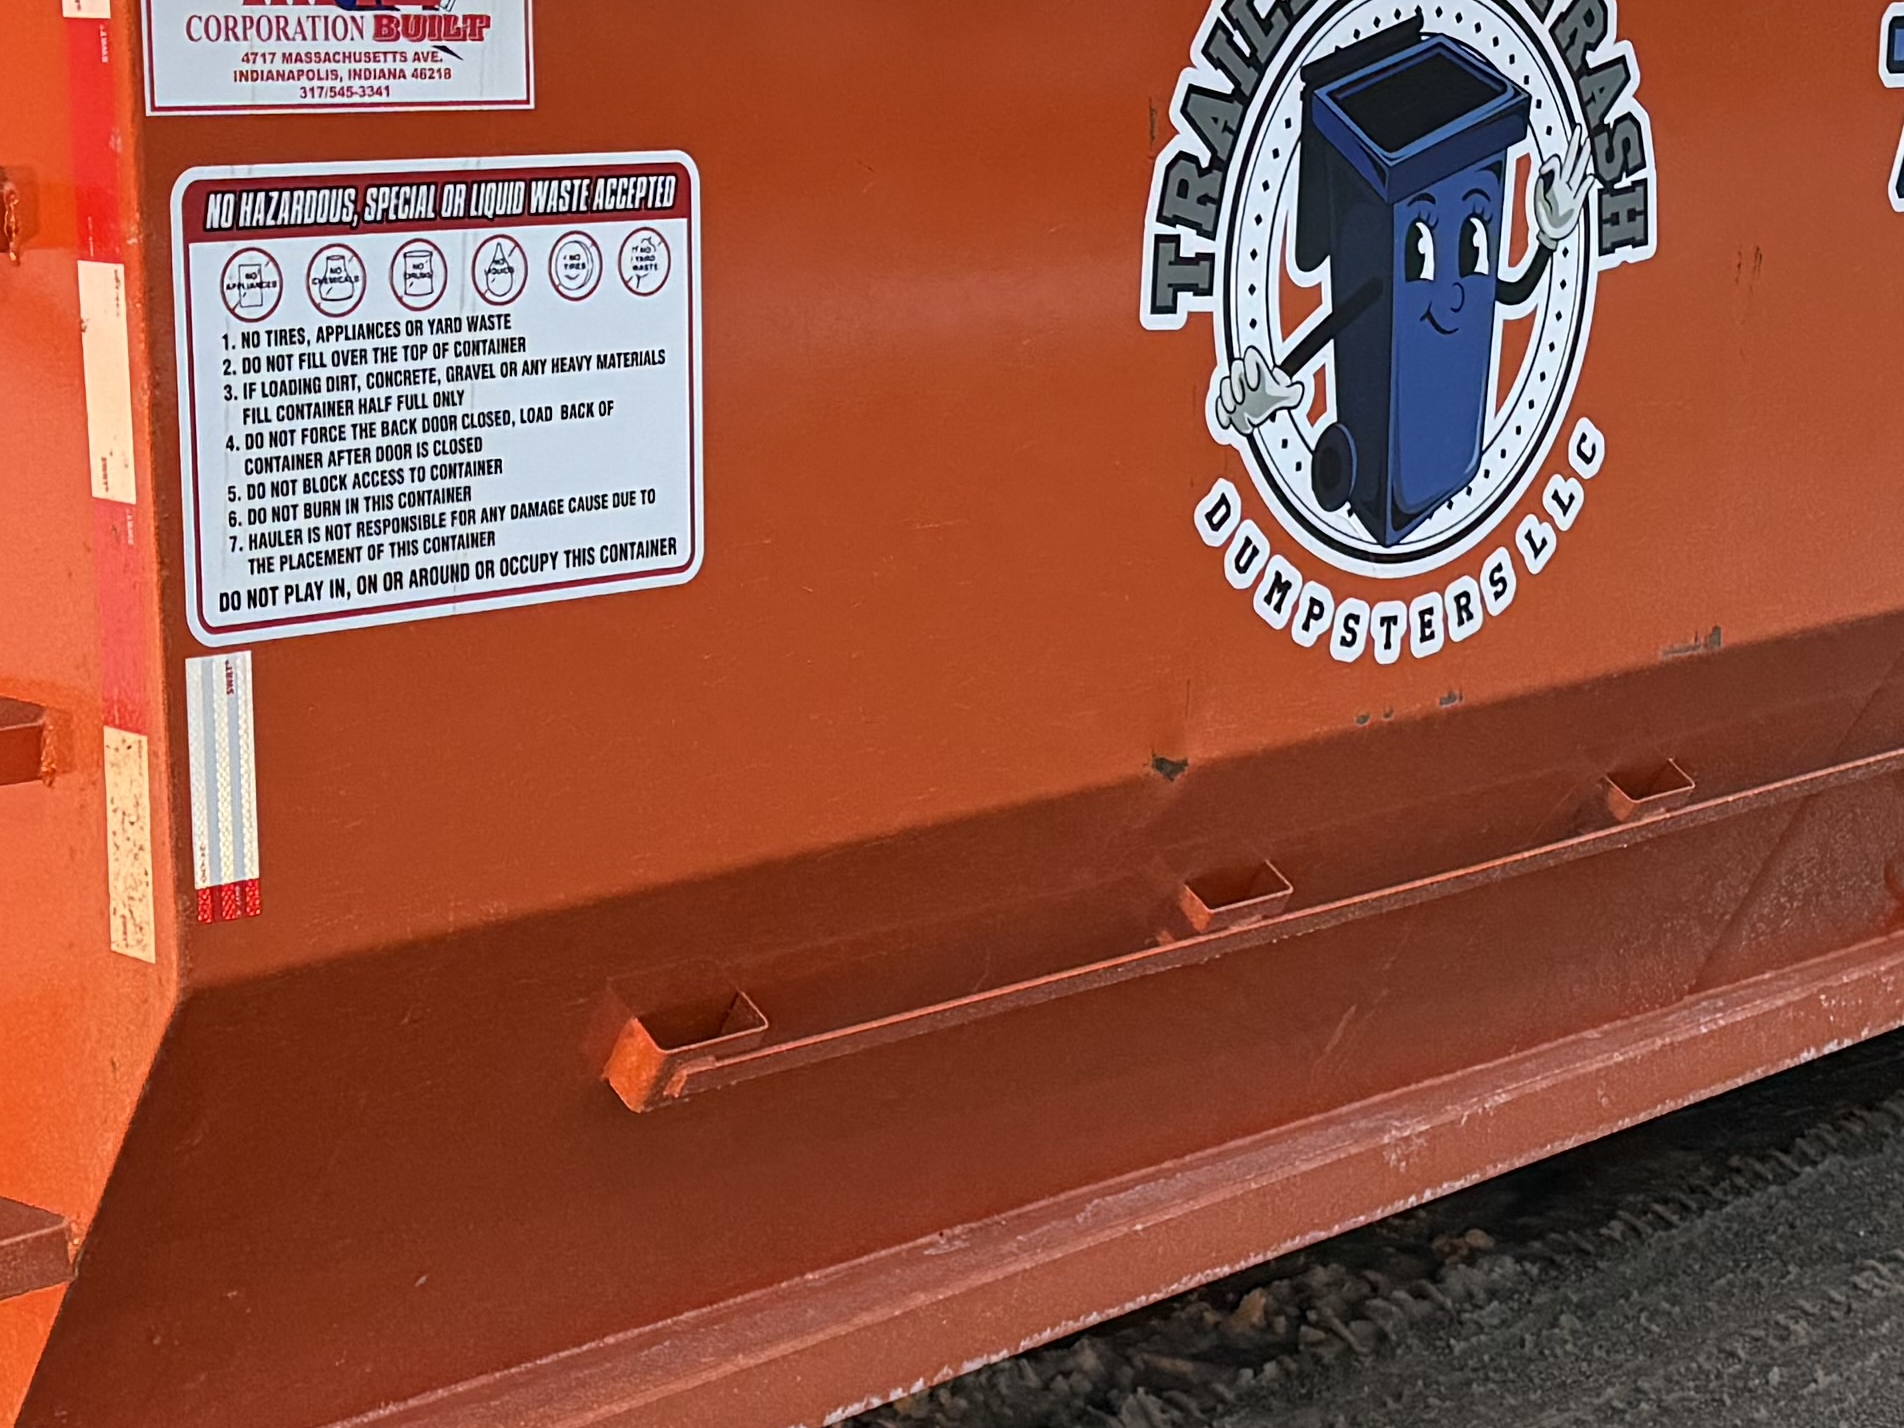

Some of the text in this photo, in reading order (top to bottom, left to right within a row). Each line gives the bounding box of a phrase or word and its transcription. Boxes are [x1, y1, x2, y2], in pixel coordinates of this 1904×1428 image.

[185, 13, 491, 43] CORPORATION BUILT
[233, 67, 452, 83] INDIANAPOLIS, INDIANA 46218
[241, 50, 443, 65] 4717 MASSACHUSETTS AVE.
[299, 85, 391, 99] 317/545-3341
[205, 175, 677, 229] NO HAZARDOUS, SPECIAL OR LIQUID WASTE ACCEPTED
[221, 313, 512, 351] 1. NO TIRES, APPLIANCES OR YARD WASTE
[222, 336, 526, 376] 2. DO NOT FILL OVER THE TOP OF CONTAINER
[223, 349, 666, 402] 3. IF LOADING DIRT, CONCRETE, GRAVEL OR ANY HEAVY MATERIALS
[225, 399, 614, 452] 4. DO NOT FORCE THE BACK DOOR CLOSED, LOAD BACK OF
[242, 389, 465, 426] FILL CONTAINER HALF FULL ONLY
[244, 436, 483, 476] CONTAINER AFTER DOOR IS CLOSED
[227, 458, 503, 503] 5. DO NOT BLOCK ACCESS TO CONTAINER
[1525, 432, 1597, 559] LLC
[228, 485, 472, 528] 6. DO NOT BURN IN THIS CONTAINER
[229, 488, 656, 553] 7. HAULER IS NOT RESPONSIBLE FOR ANY DAMAGE CAUSE DUE TO
[219, 537, 677, 613] DO NOT PLAY IN, ON OR AROUND OR OCCUPY THIS CONTAINER
[247, 530, 496, 576] THE PLACEMENT OF THIS CONTAINER
[1205, 492, 1508, 651] DUMPSTERS
